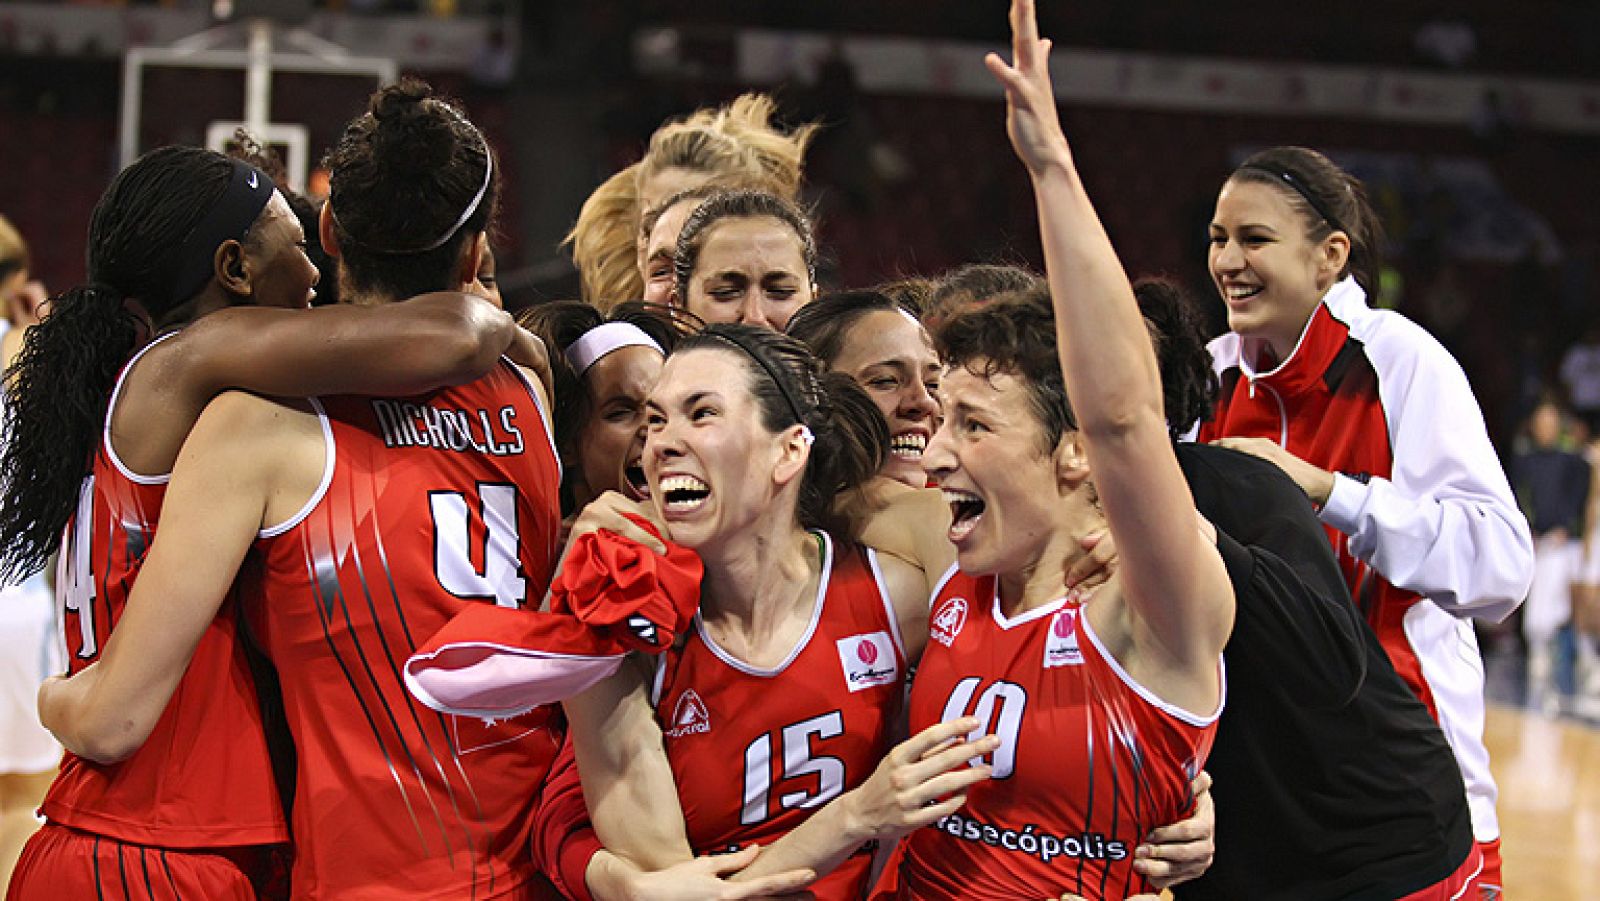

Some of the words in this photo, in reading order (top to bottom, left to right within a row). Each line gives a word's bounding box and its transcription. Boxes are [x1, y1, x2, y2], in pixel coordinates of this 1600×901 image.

[372, 400, 526, 455] NICHOLLS
[427, 480, 528, 608] 4
[740, 709, 846, 826] 15
